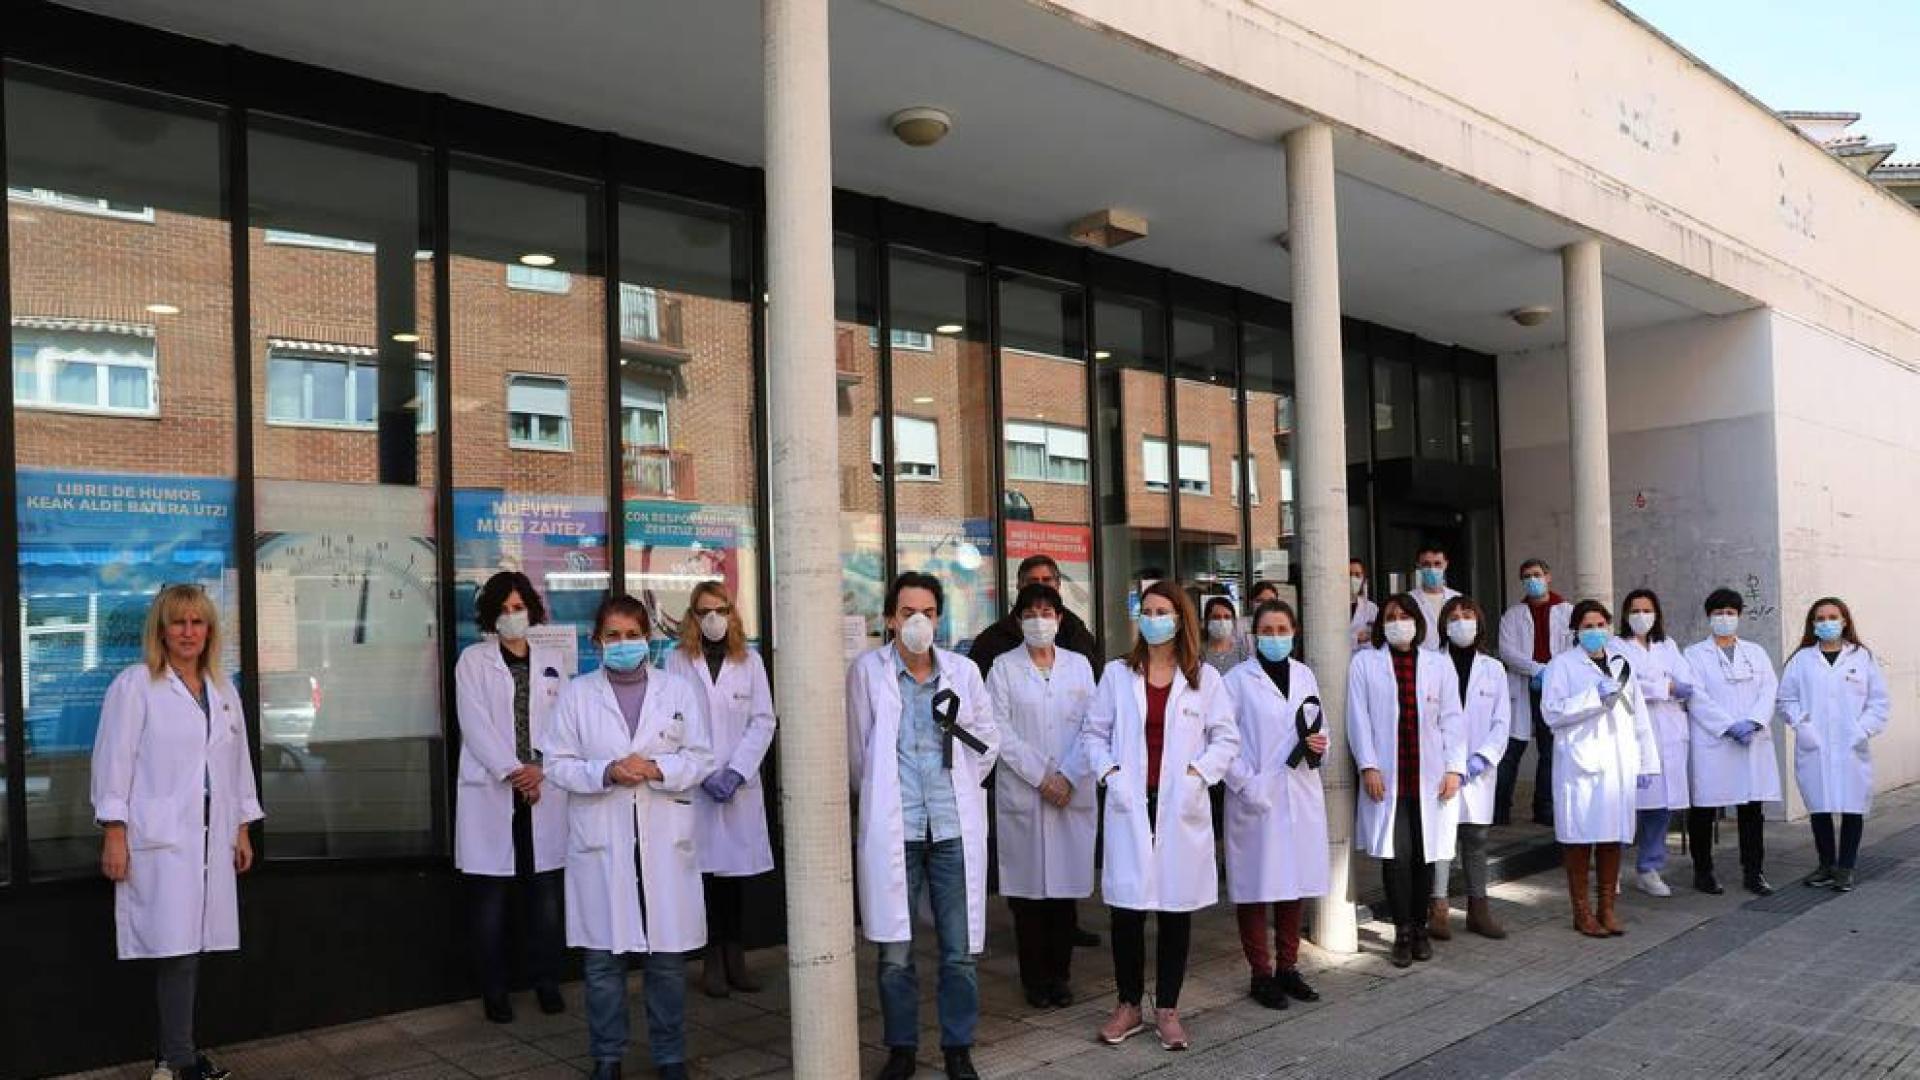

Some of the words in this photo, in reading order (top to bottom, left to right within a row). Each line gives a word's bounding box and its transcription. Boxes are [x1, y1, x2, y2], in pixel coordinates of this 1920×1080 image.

[55, 482, 108, 497] LIBRE
[112, 486, 135, 498] DE
[139, 487, 201, 501] HUMOS
[27, 495, 75, 509] KEAK
[79, 498, 123, 513] ALDE
[477, 519, 524, 534] MUGI
[528, 521, 587, 537] ZAITEZ
